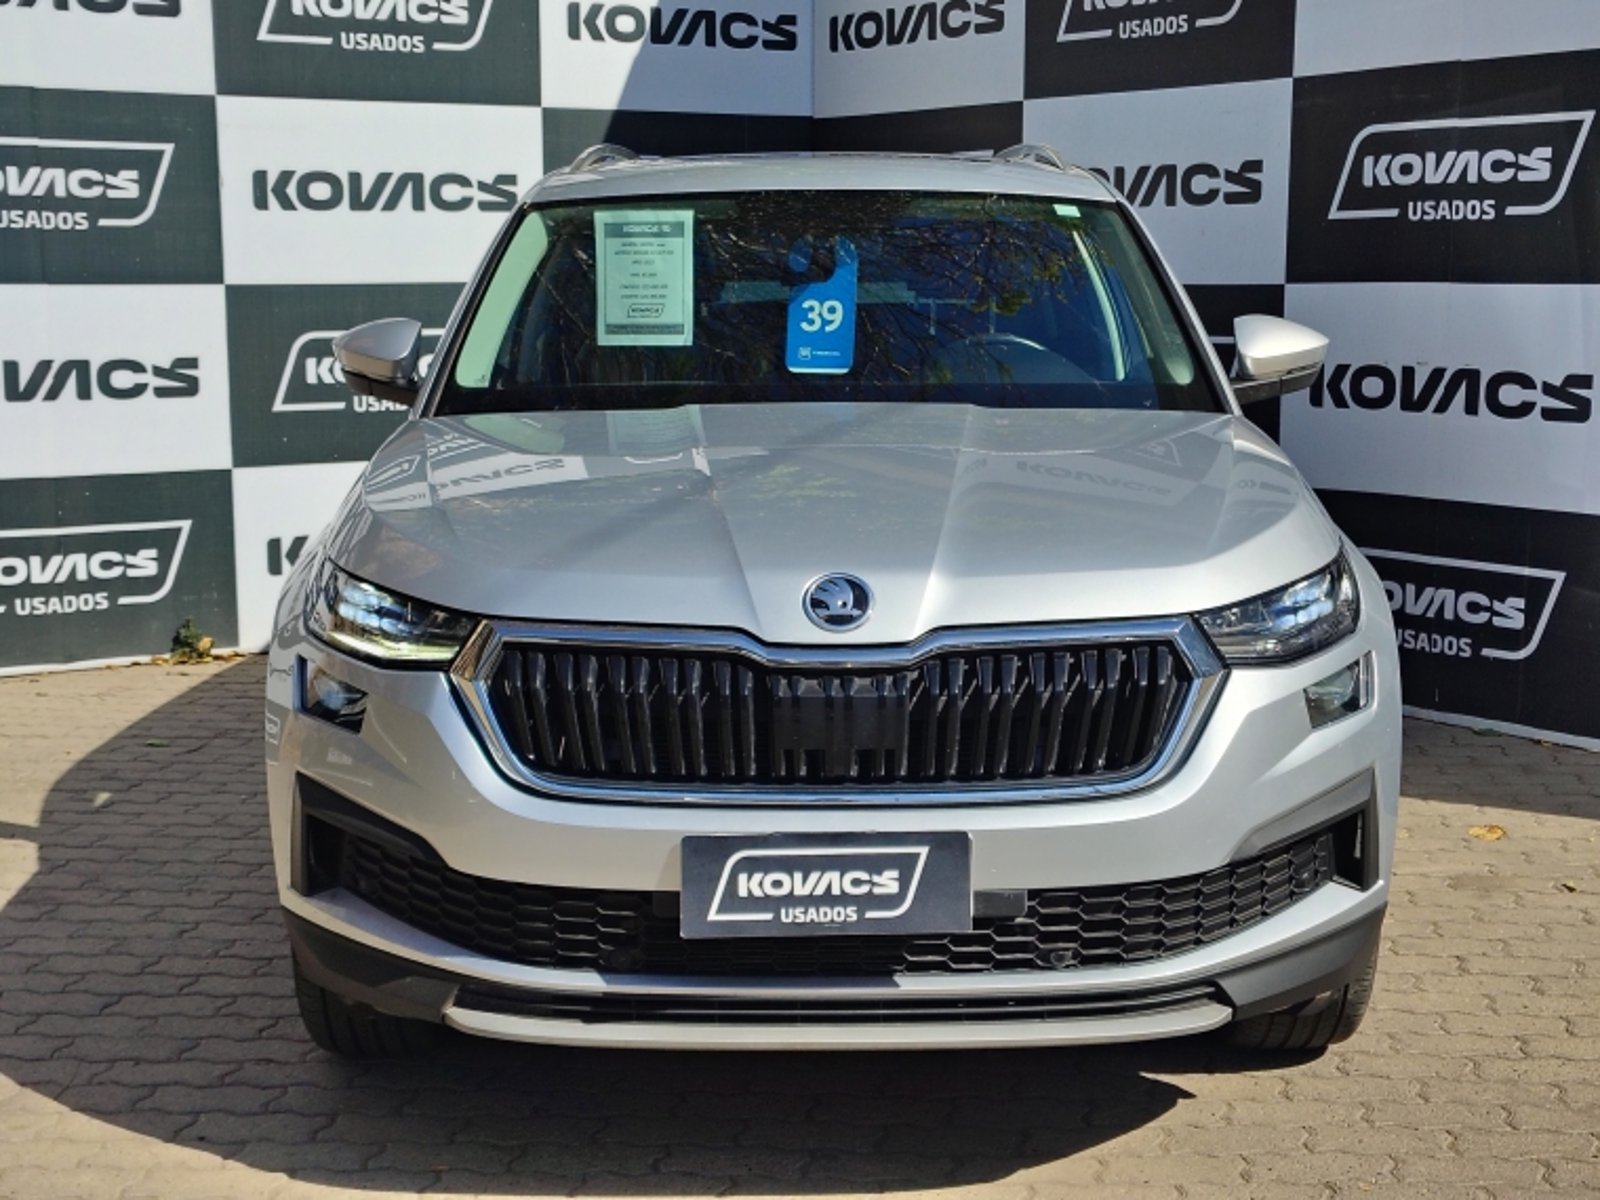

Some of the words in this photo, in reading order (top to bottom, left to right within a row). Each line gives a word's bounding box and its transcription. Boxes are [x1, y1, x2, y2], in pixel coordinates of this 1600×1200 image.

[340, 31, 426, 53] USADOS
[567, 2, 798, 51] KOVACS
[829, 0, 1006, 53] KOVACS
[1118, 14, 1189, 39] USADOS
[0, 165, 140, 198] VACS
[1088, 159, 1264, 207] VACS
[1362, 146, 1553, 188] KOVACS
[252, 170, 519, 212] KOVACS
[1407, 200, 1496, 221] USADOS
[800, 299, 843, 333] 39
[1308, 363, 1595, 424] KOVACS
[14, 591, 110, 616] USADOS
[738, 869, 900, 898] KOVACS
[780, 906, 858, 924] USADOS
